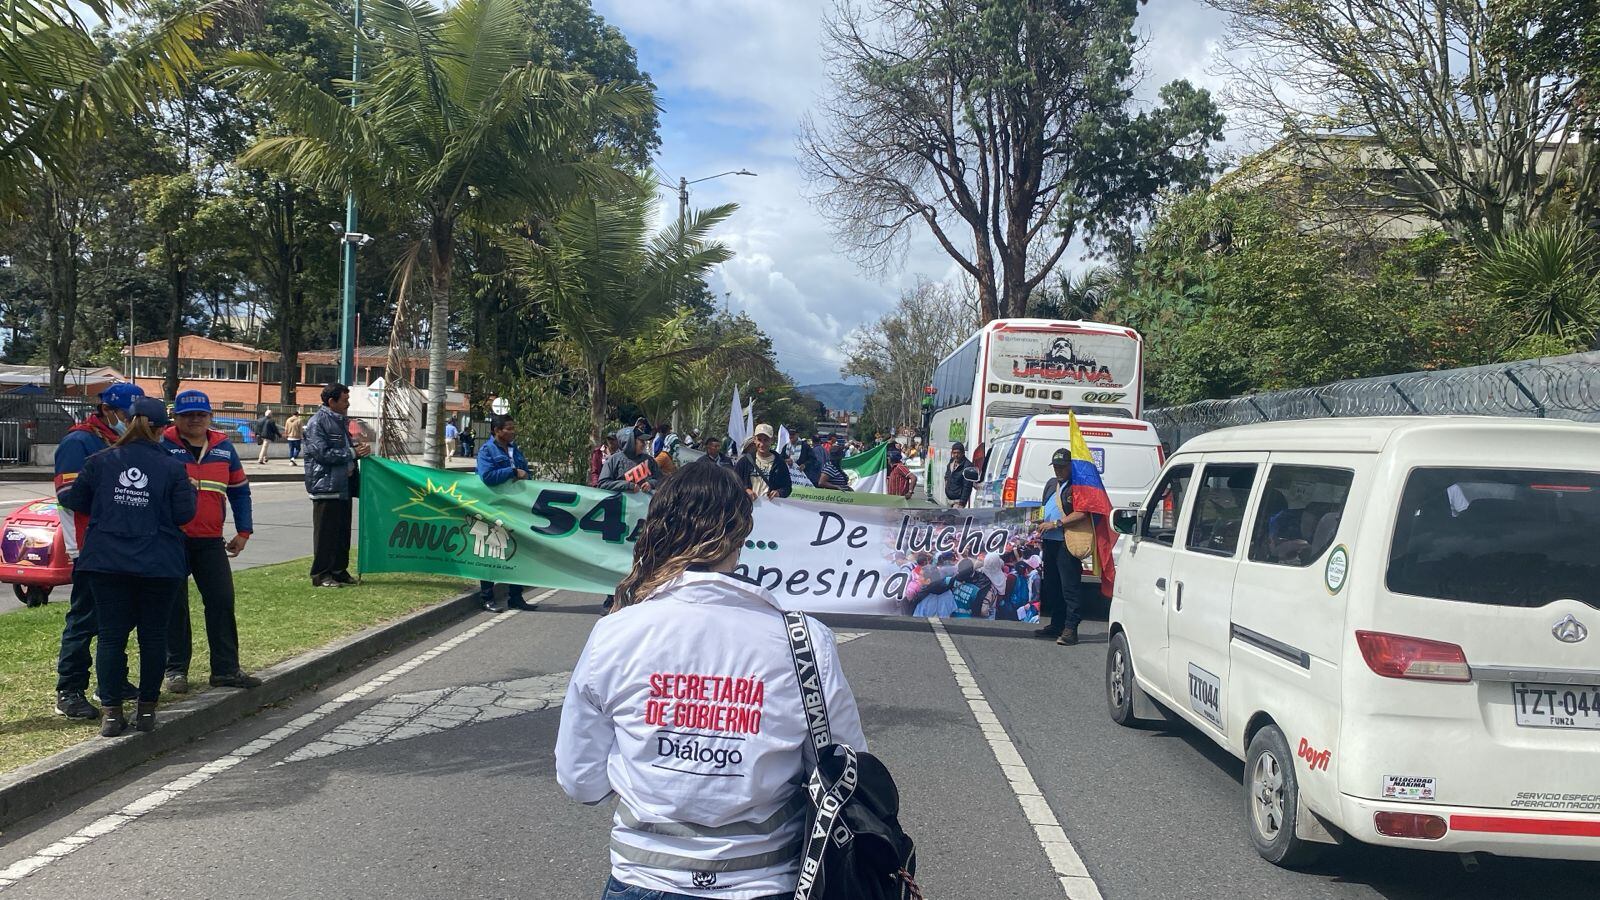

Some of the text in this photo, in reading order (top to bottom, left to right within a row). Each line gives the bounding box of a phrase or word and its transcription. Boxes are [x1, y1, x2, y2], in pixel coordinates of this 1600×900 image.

[1012, 359, 1113, 382] URBANA
[126, 494, 149, 503] Pueblo
[791, 492, 825, 501] ampesinos
[530, 489, 629, 544] 54
[810, 511, 868, 548] De
[896, 514, 1009, 555] lucha
[649, 672, 764, 707] SECRETARÍA
[1189, 673, 1218, 712] TZT044
[645, 700, 761, 734] DE GOBIERNO
[803, 674, 830, 749] BIMBA
[1550, 717, 1575, 725] FUNZA
[657, 737, 743, 768] Diálogo
[1389, 776, 1433, 784] VELOCIDAD
[1511, 799, 1566, 808] OPERACION
[1516, 792, 1562, 800] SERVICIO
[813, 796, 839, 839] OLA
